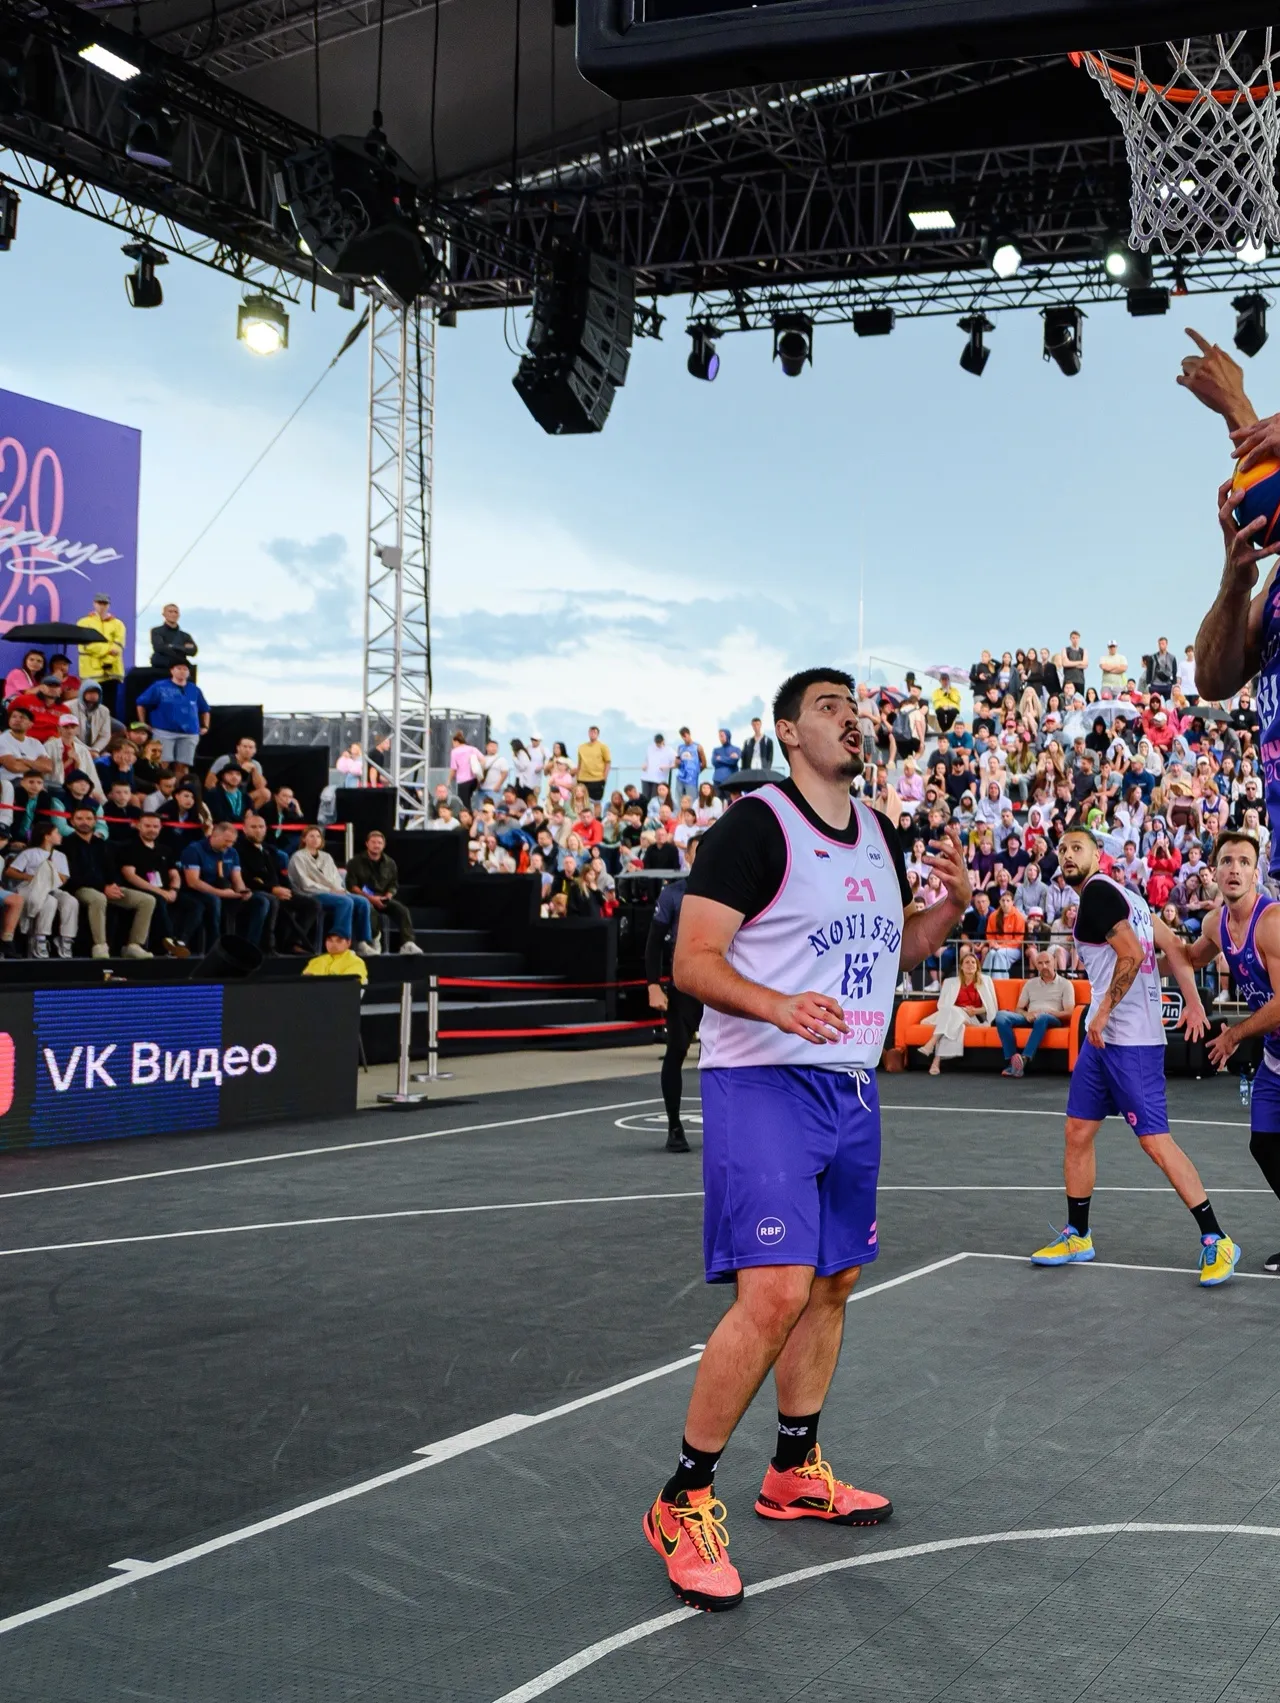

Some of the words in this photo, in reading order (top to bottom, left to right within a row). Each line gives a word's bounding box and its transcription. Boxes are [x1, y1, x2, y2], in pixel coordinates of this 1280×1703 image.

[844, 876, 876, 902] 21
[808, 913, 866, 957] NOVI
[43, 1044, 118, 1092] VK
[131, 1041, 277, 1088] Видео
[760, 1226, 782, 1236] RBF
